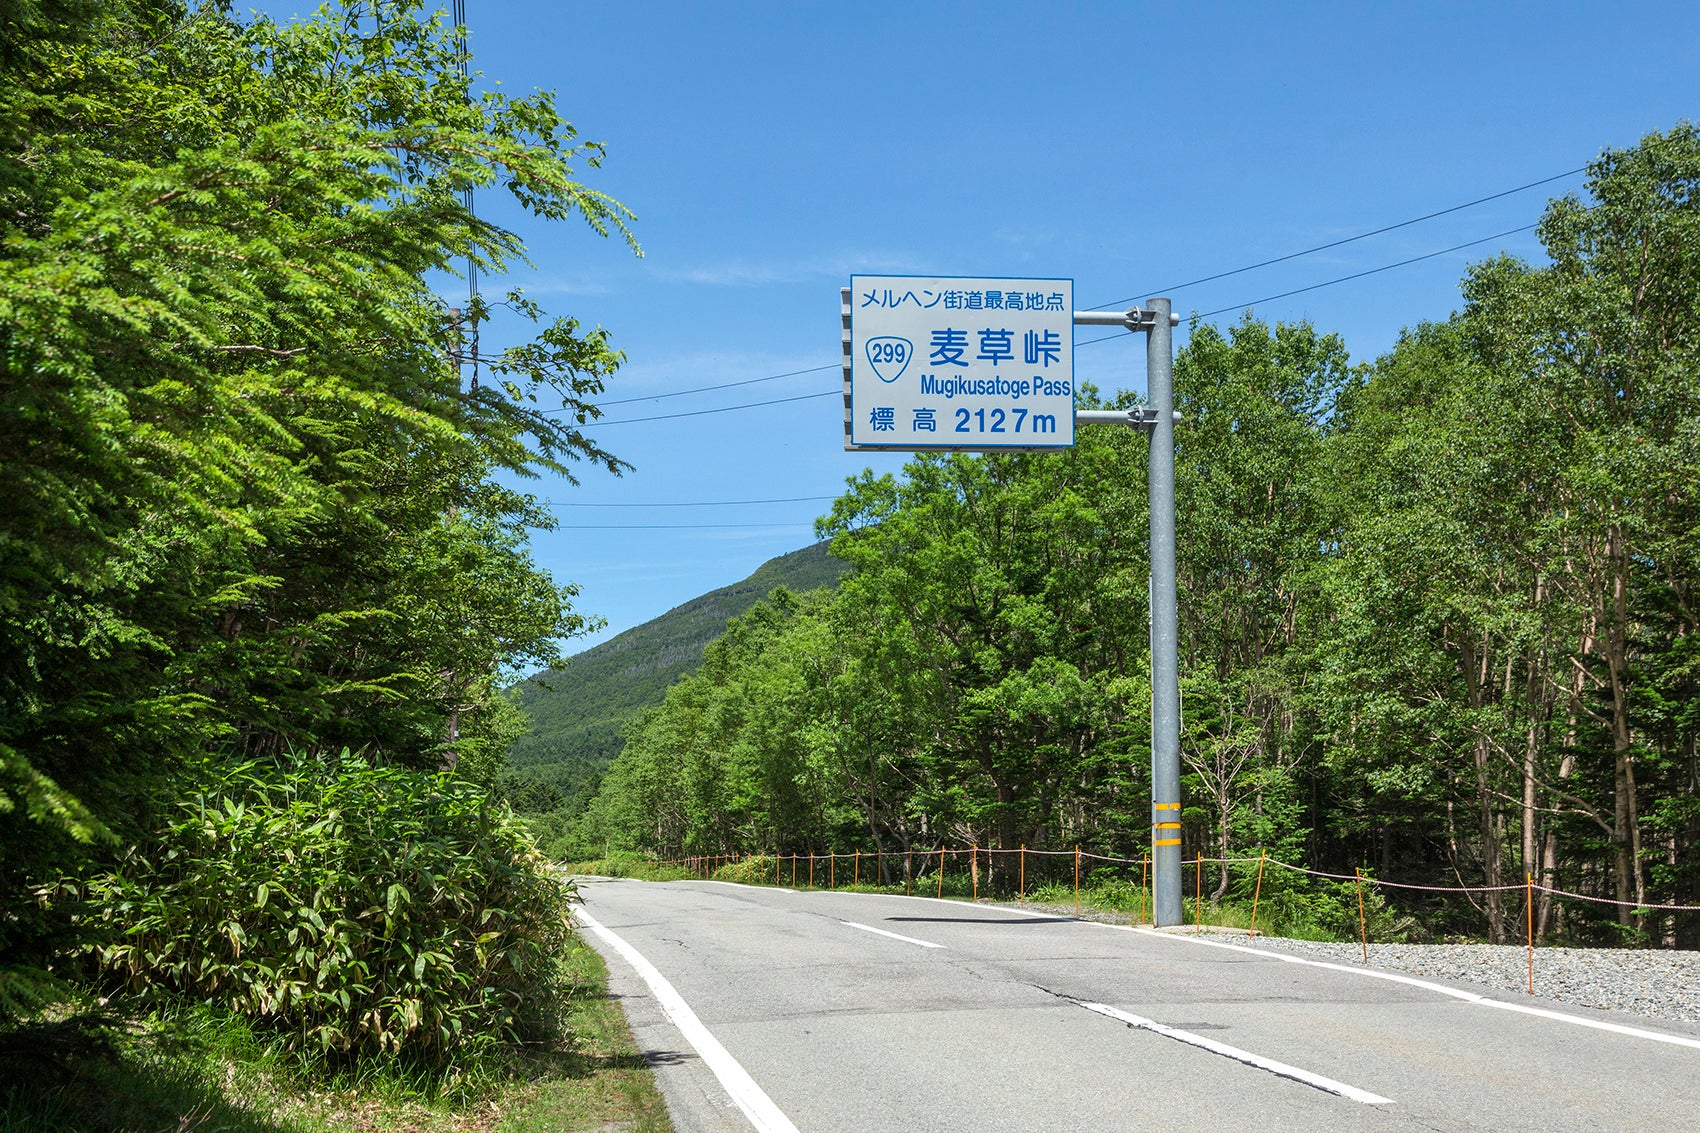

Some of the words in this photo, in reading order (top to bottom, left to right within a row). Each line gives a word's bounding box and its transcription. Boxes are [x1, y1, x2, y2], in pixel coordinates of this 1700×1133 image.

[861, 289, 1065, 312] メルヘン街道最高地点
[872, 343, 906, 364] 299
[929, 327, 1062, 368] 麦草峠
[920, 374, 1030, 399] Mugikusatoge
[1033, 375, 1071, 397] Pass
[954, 407, 1056, 434] 2127m
